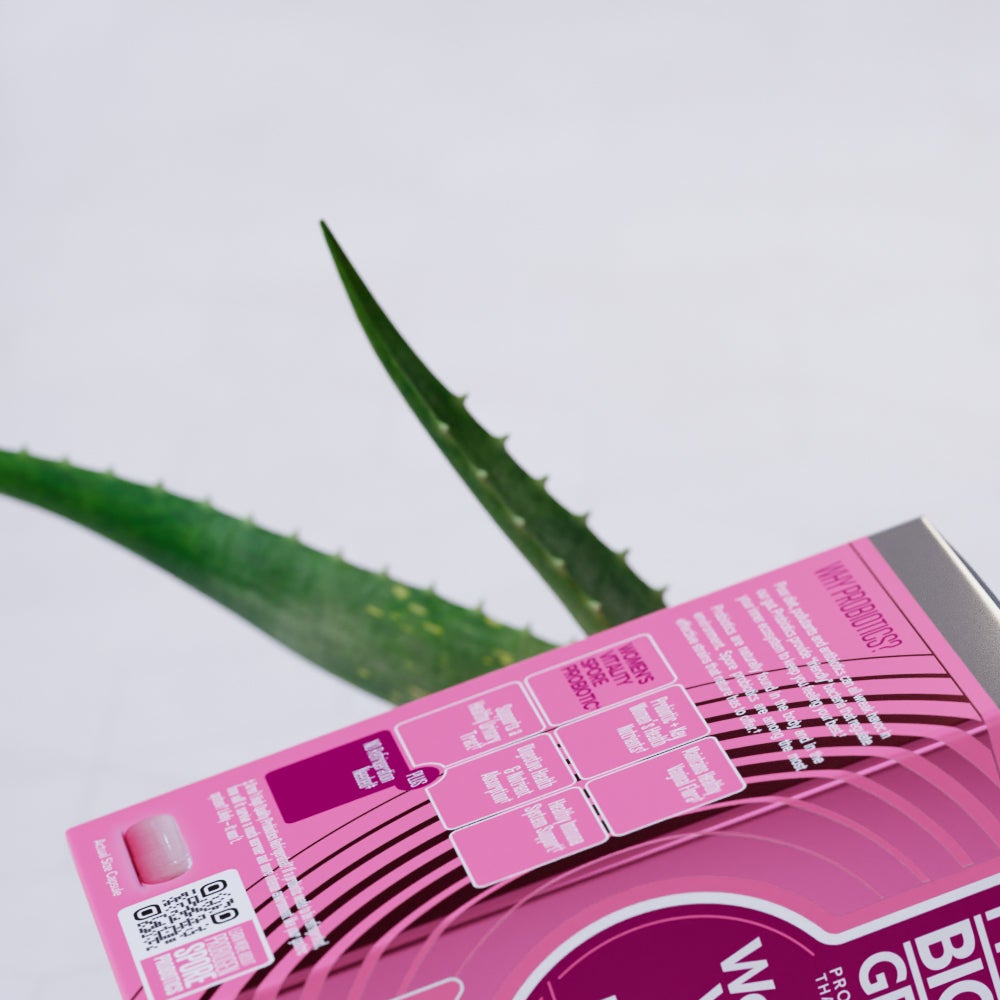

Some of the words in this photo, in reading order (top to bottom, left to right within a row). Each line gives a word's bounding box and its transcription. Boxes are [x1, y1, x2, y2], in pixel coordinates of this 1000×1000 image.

[815, 564, 855, 590] WHY
[832, 584, 903, 653] PROBIOTICS?
[580, 658, 609, 687] SPORE
[407, 770, 427, 787] PLUS
[106, 870, 124, 897] Capsule
[173, 941, 219, 989] SPORE
